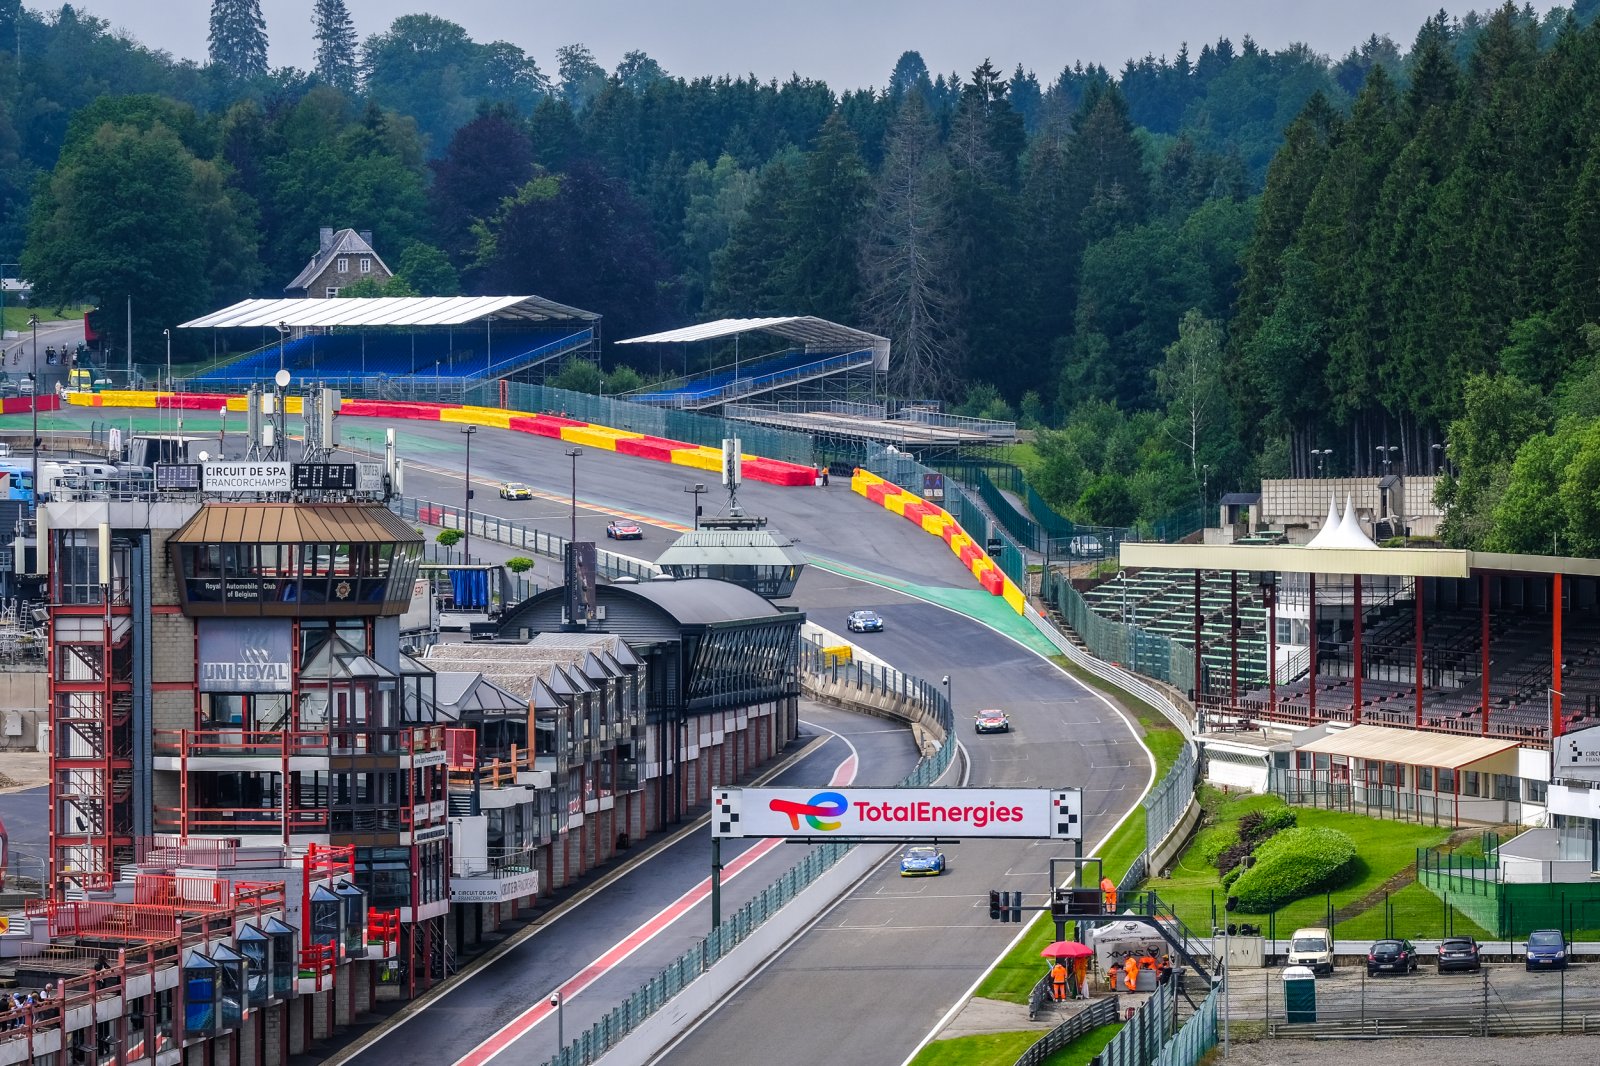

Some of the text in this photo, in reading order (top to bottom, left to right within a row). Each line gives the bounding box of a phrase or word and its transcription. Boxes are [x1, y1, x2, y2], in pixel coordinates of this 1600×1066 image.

[205, 466, 287, 476] CIRCUIT DE SPA
[205, 478, 287, 487] FRANCORCHAMPS
[205, 582, 276, 591] Royal Automobile Club
[227, 590, 258, 599] of Belgium
[203, 663, 288, 681] UNIROYAL
[852, 799, 1024, 828] TotalEnergies
